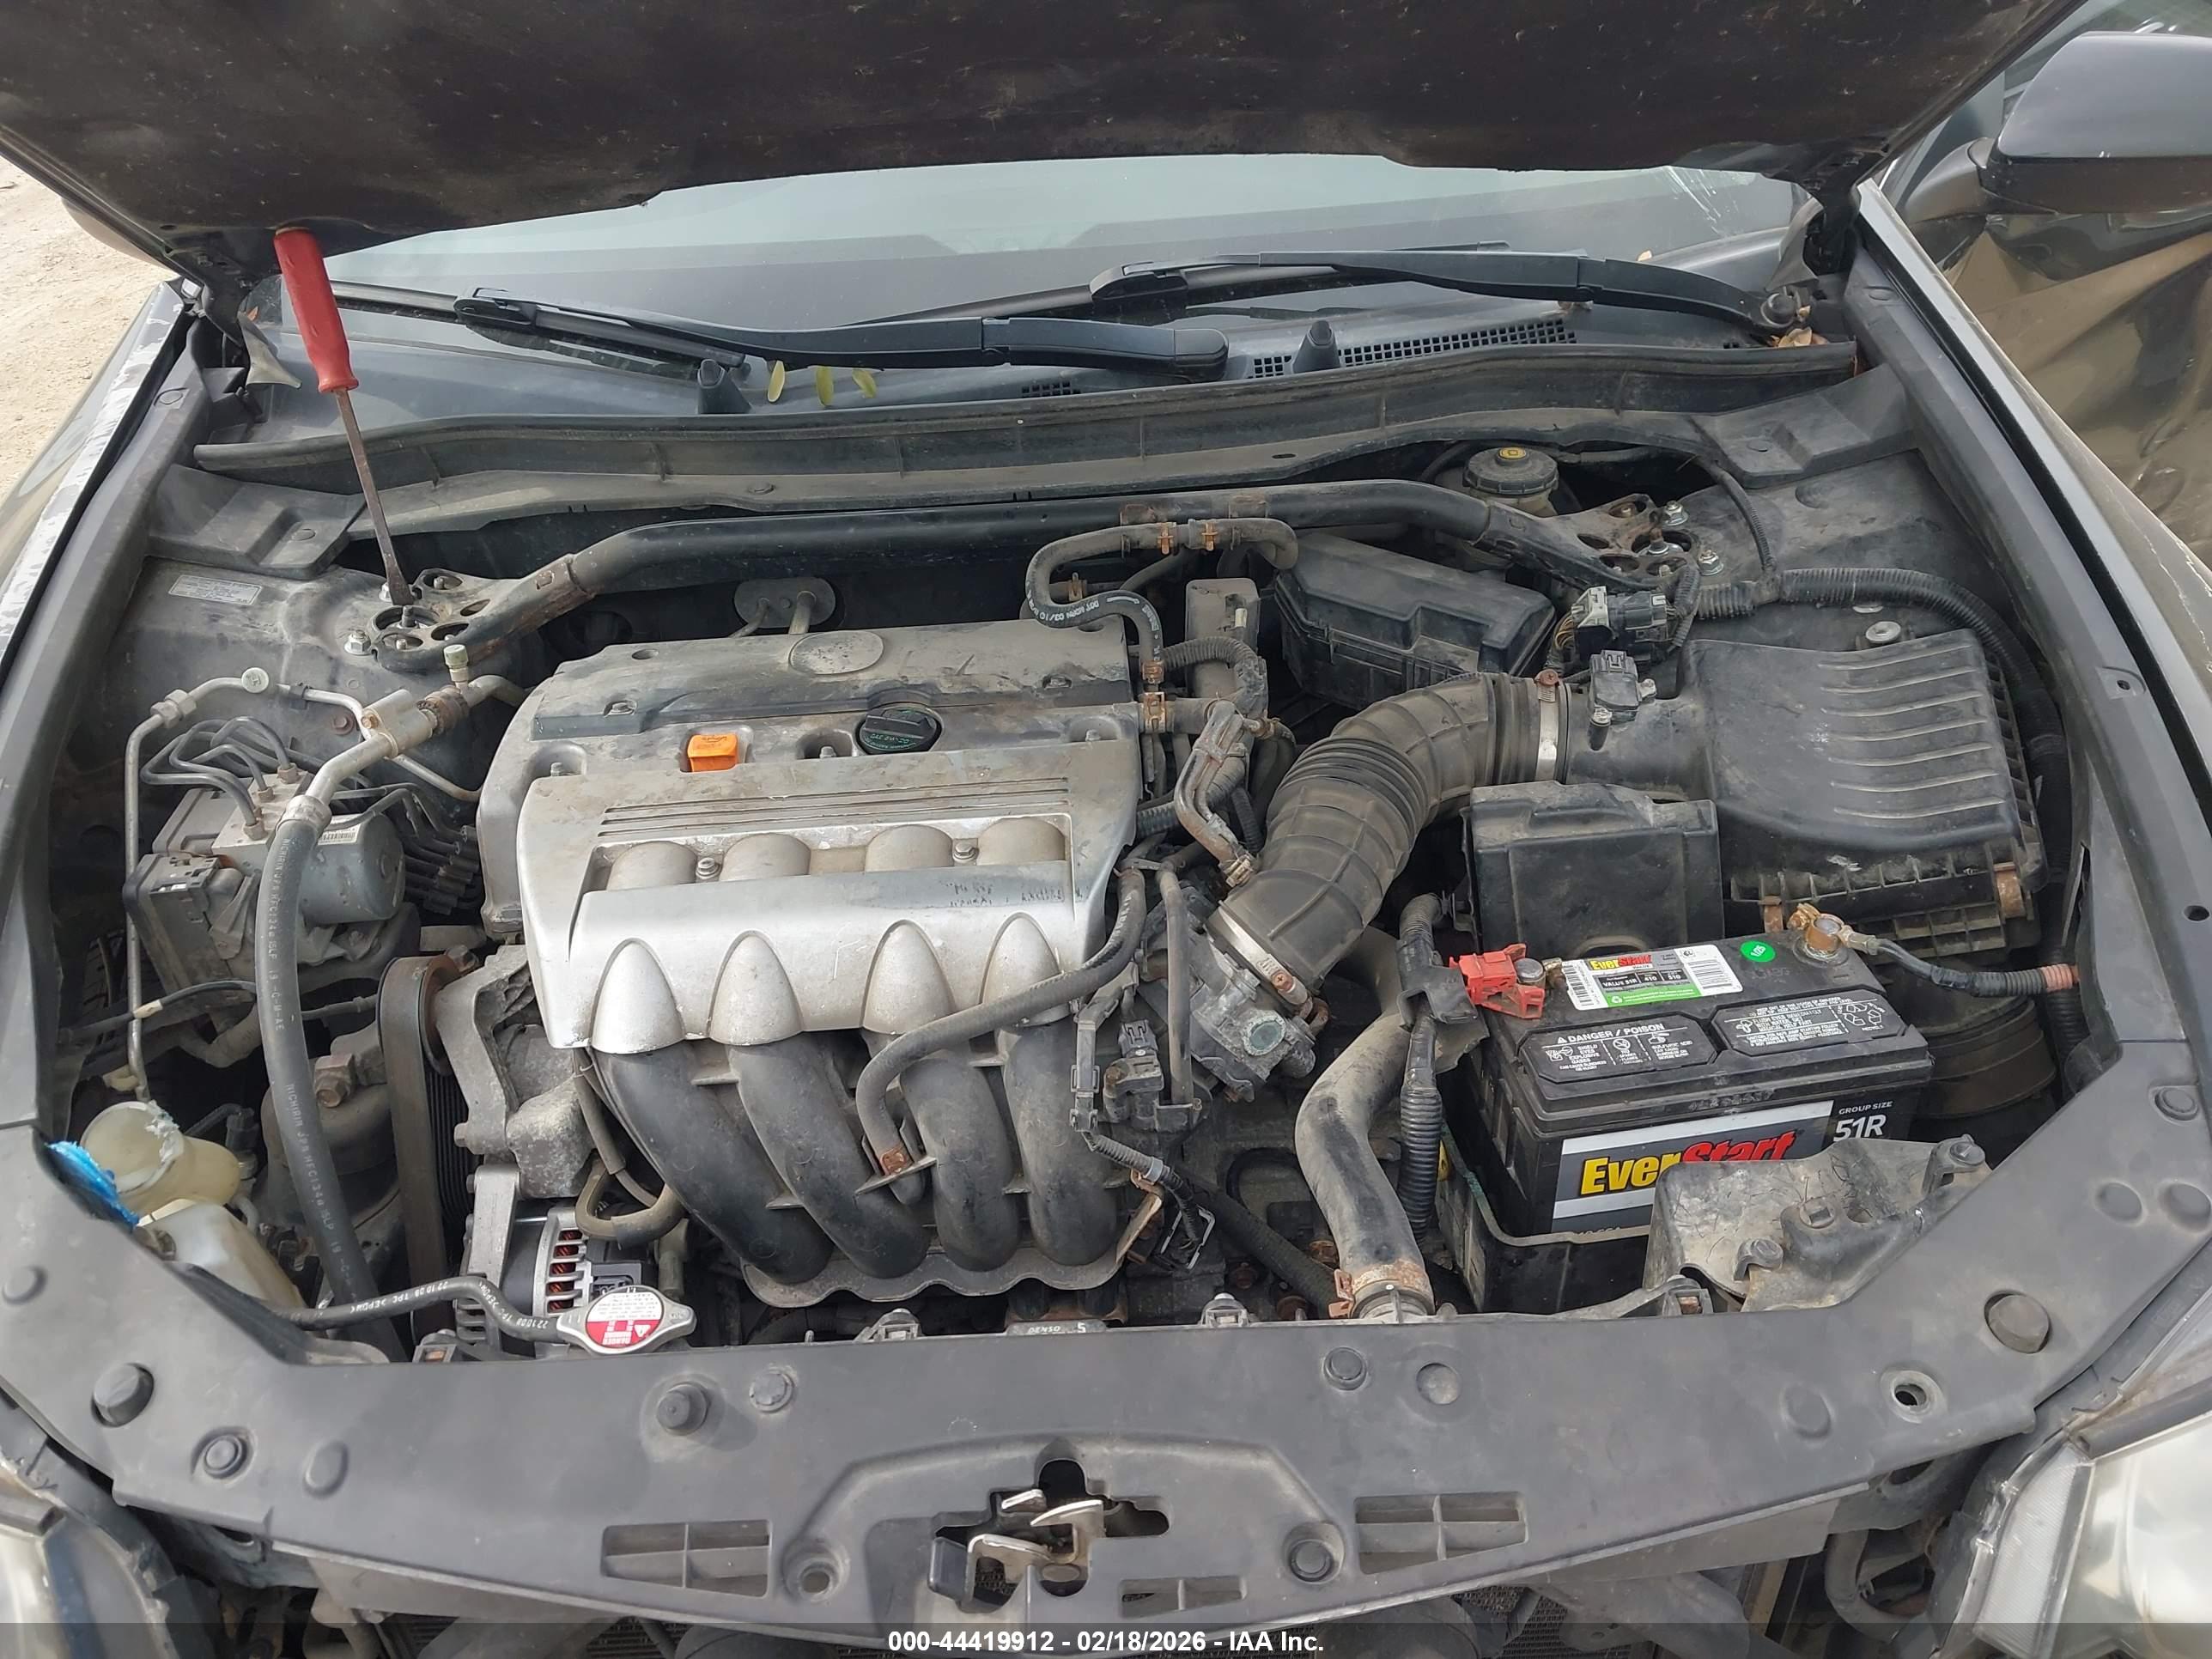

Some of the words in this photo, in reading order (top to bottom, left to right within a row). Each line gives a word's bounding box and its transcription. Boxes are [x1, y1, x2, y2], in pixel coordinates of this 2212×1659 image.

[1568, 1030, 1613, 1043] DANGER
[1624, 1023, 1665, 1036] POISON
[1839, 1104, 1870, 1115] GROUP
[1870, 1101, 1893, 1110] SIZE
[1834, 1115, 1887, 1142] 51R
[1027, 1325, 1061, 1334] DENSO
